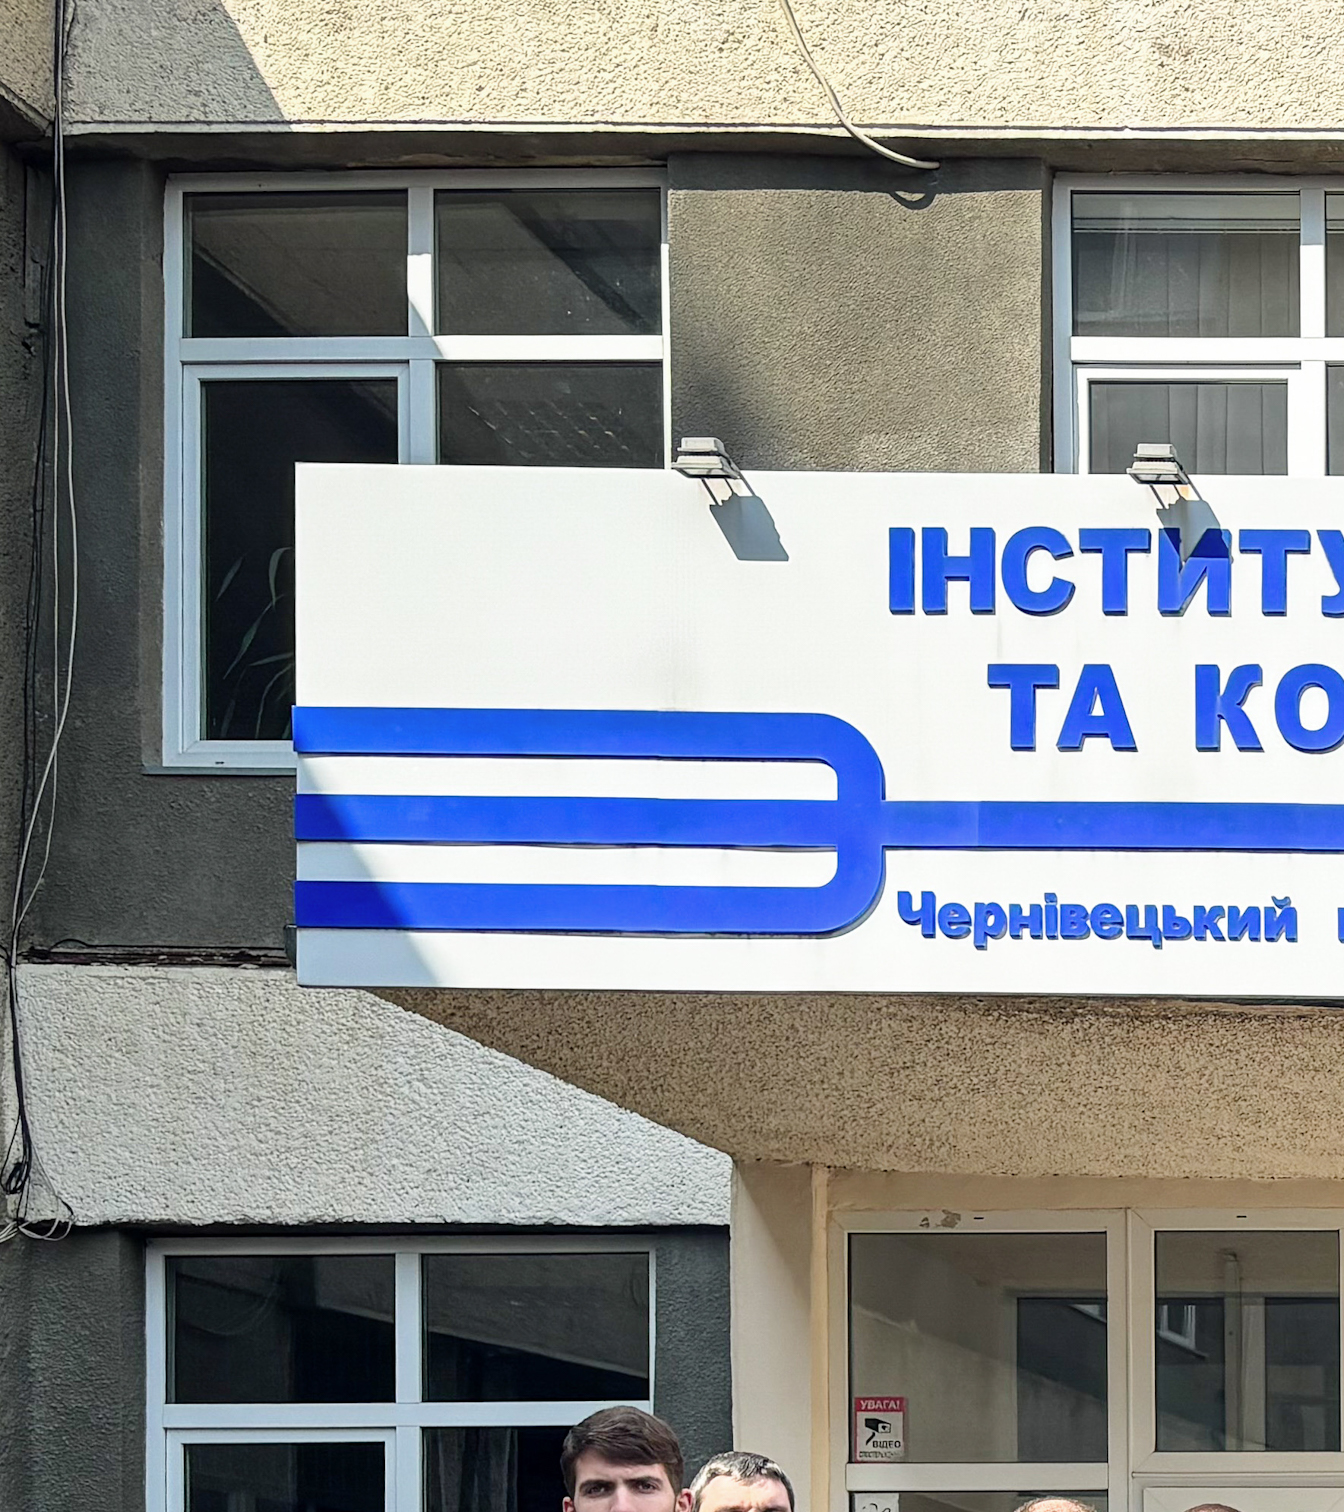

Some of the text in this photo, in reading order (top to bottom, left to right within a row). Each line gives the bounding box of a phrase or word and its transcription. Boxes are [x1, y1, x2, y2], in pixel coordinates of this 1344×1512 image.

[987, 663, 1138, 753] ТА
[896, 890, 1299, 951] Чернівецький
[860, 1399, 900, 1410] УВАГА!
[872, 1440, 901, 1449] ВІДЕО
